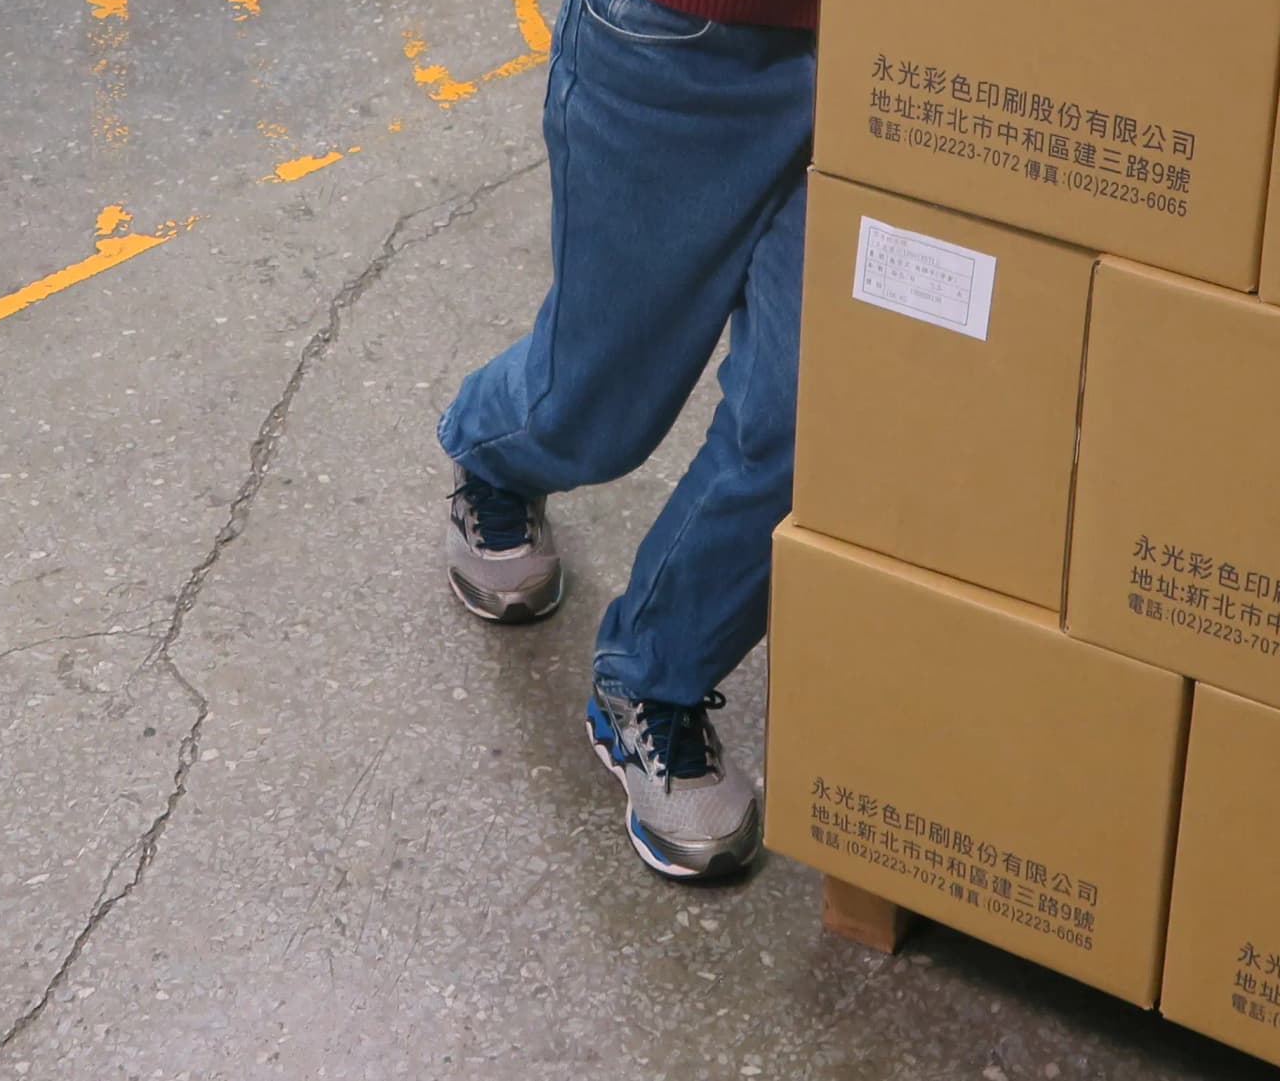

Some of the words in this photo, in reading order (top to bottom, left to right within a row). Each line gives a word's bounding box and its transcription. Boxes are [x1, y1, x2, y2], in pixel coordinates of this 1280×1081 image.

[871, 54, 1198, 161] 永光彩色印刷股份有限公司
[812, 776, 1098, 907] 永光彩色印刷股份有限公司
